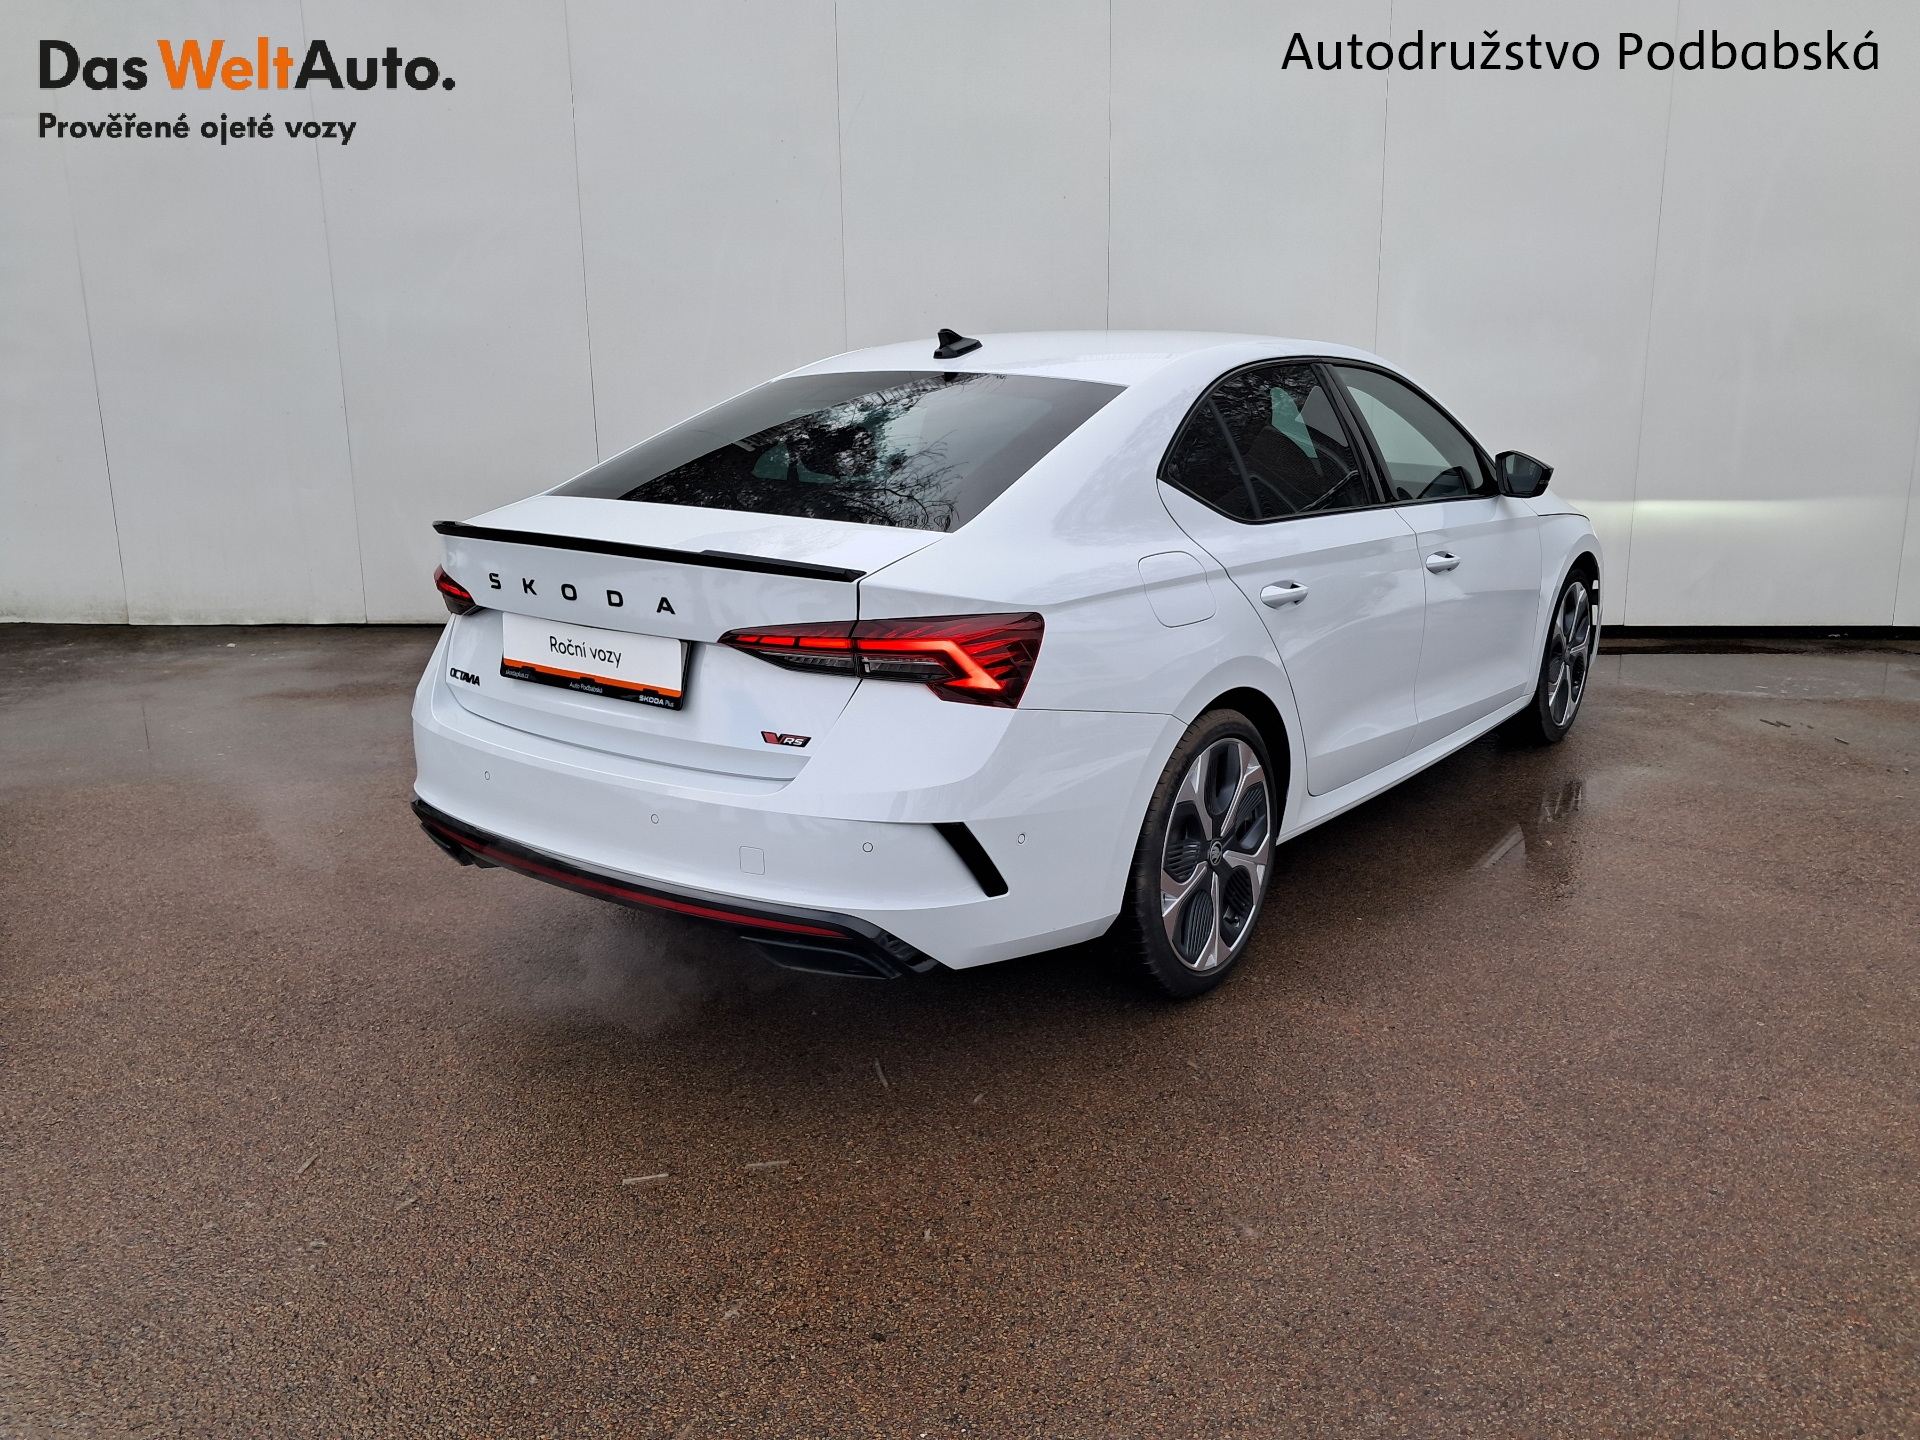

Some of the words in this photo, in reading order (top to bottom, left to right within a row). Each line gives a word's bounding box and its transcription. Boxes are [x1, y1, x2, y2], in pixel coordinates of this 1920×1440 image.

[549, 635, 587, 658] Roční
[589, 646, 622, 669] vozy
[450, 667, 480, 687] OCTAVIA
